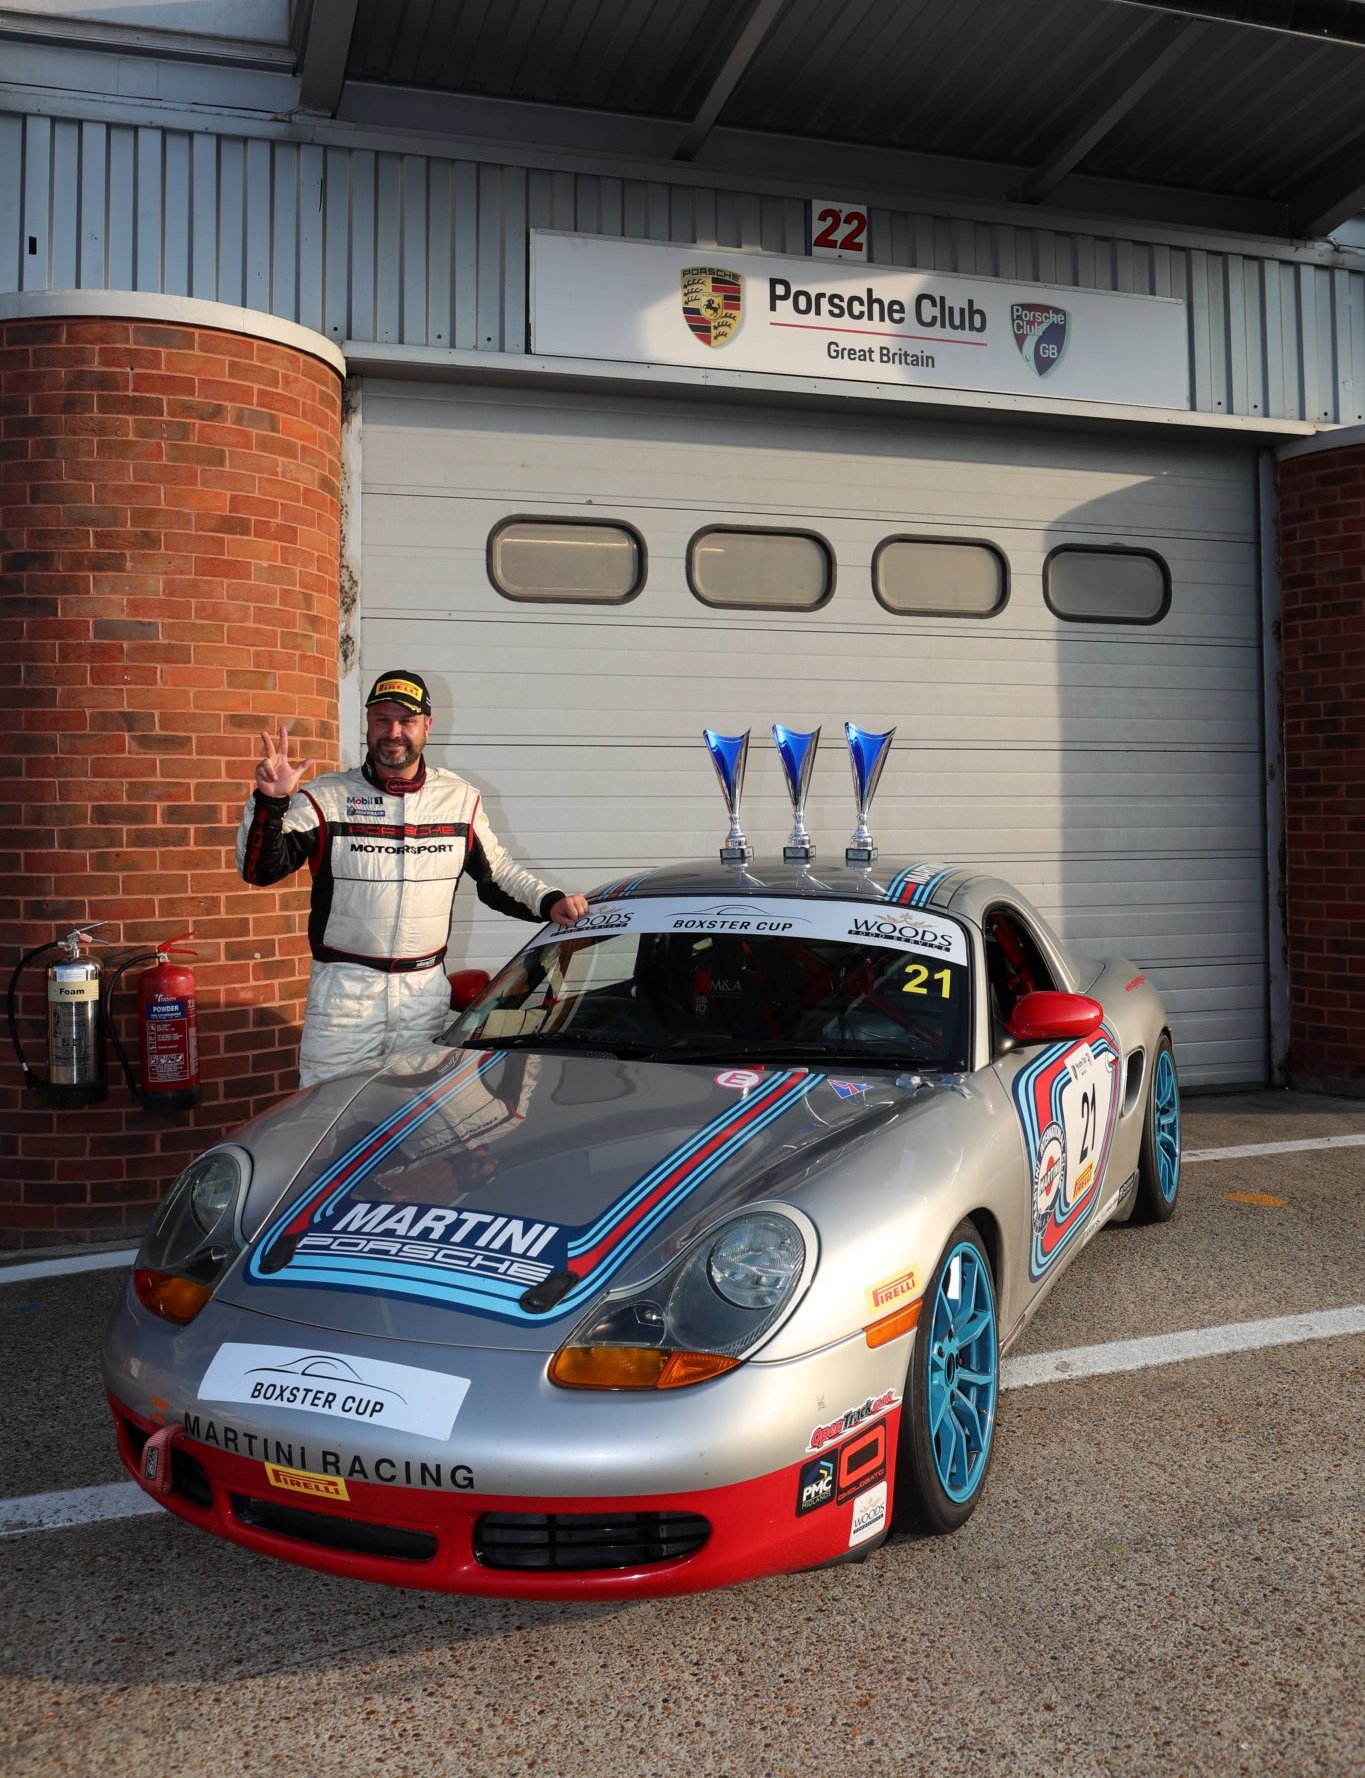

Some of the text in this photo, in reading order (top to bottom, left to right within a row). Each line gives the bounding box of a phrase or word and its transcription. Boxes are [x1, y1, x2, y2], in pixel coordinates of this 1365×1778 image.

[813, 209, 867, 251] 22
[682, 267, 740, 281] PORSCHE
[769, 277, 987, 333] Porsche Club
[1012, 305, 1065, 325] Porsche
[1013, 319, 1043, 336] Club
[827, 341, 935, 368] Great Britain
[1040, 344, 1058, 358] GB
[347, 797, 373, 805] Mobil
[349, 825, 455, 835] PORSCHE
[350, 844, 454, 855] MOTORSPORT
[672, 919, 793, 932] BOXSTER CUP
[850, 930, 886, 940] FOOD
[853, 918, 953, 947] WOODS
[59, 987, 85, 996] Foam
[710, 979, 742, 991] M&A
[902, 964, 952, 999] 21
[1079, 1083, 1097, 1165] 21
[1073, 1162, 1094, 1199] PIRELLI
[332, 1203, 559, 1257] MARTINI
[297, 1236, 552, 1284] PORSCHE
[872, 1271, 915, 1307] PIRELLI
[250, 1381, 385, 1418] BOXSTER CUP
[184, 1411, 307, 1470] MARTINI
[322, 1450, 475, 1489] RACING
[272, 1468, 340, 1496] PIRELLI
[802, 1476, 832, 1502] PMC
[854, 1503, 885, 1528] WOODS
